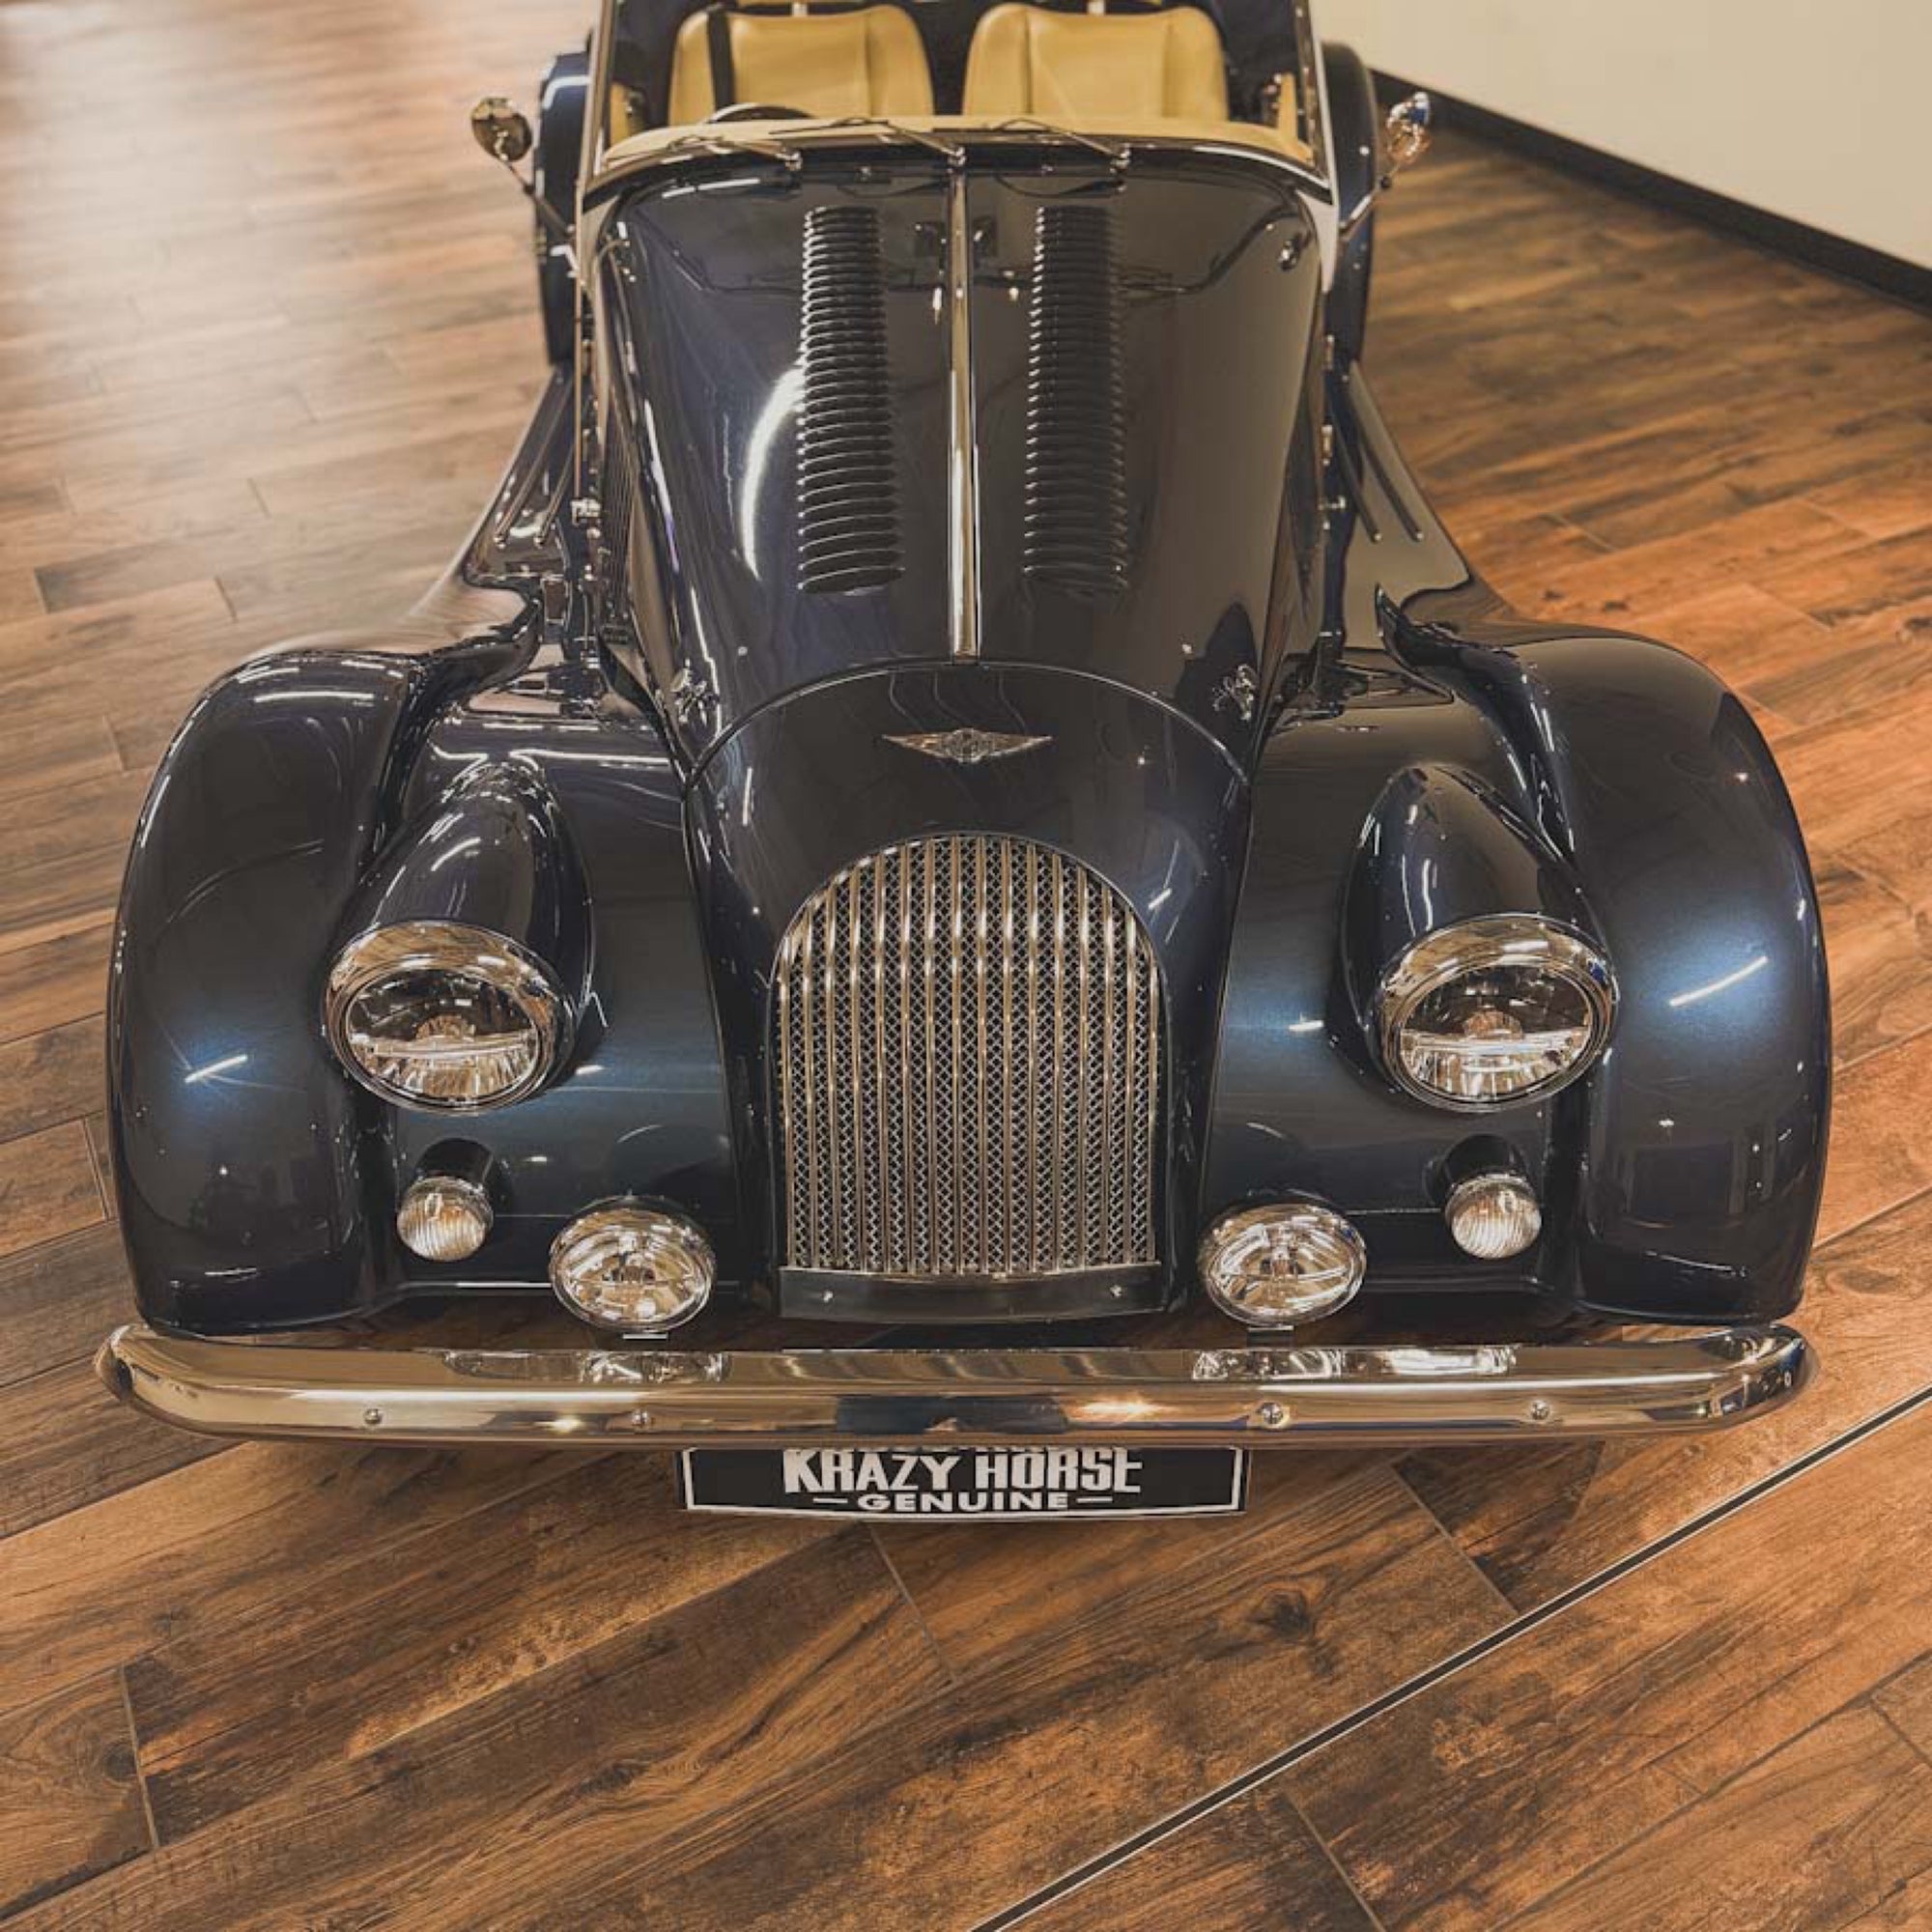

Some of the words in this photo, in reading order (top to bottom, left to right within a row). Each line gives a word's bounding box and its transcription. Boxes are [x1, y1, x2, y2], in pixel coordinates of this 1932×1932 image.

[783, 1448, 961, 1492] KRAZY
[975, 1447, 1143, 1492] HORSE
[857, 1492, 1068, 1512] GENUINE
